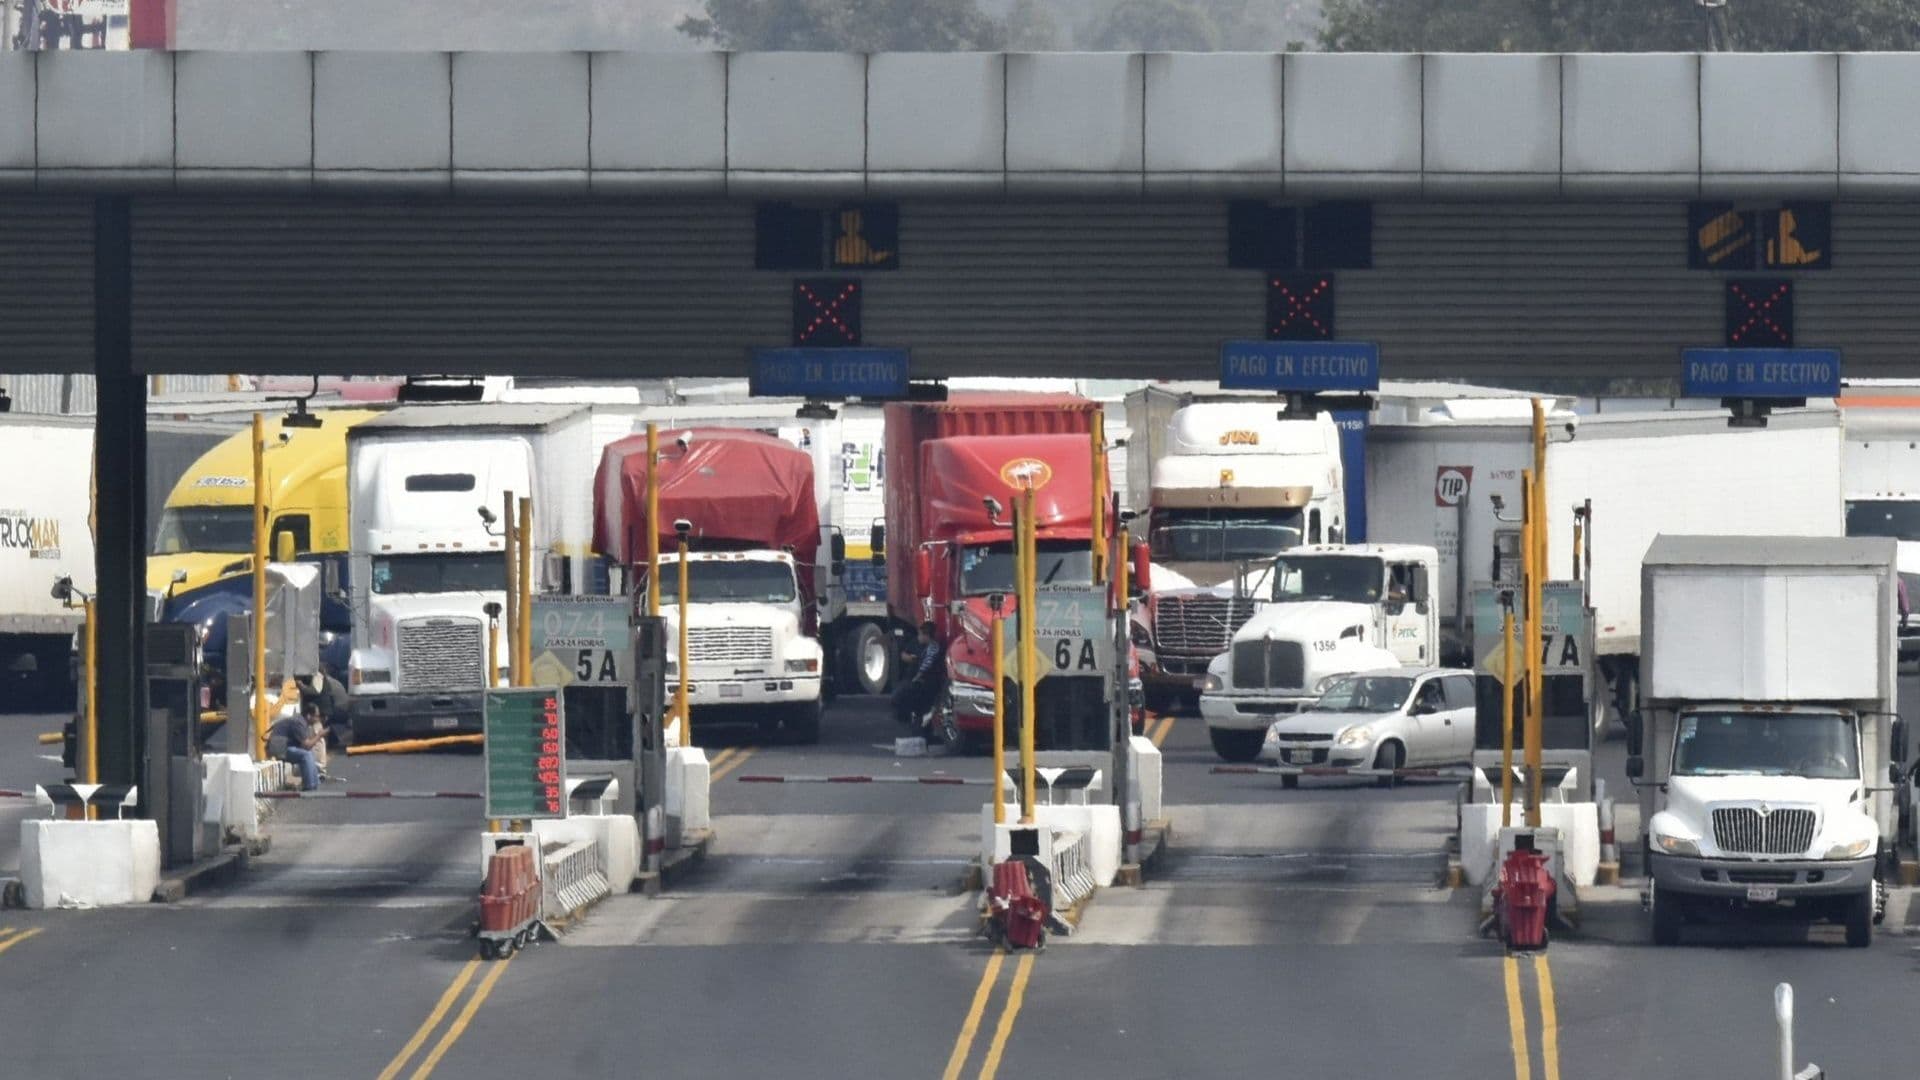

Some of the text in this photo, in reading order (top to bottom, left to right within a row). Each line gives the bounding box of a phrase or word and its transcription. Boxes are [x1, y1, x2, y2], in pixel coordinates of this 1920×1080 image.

[805, 362, 823, 382] EN
[831, 361, 898, 383] EFECTIVO
[1230, 356, 1368, 376] PAGO EN EFECTIVO
[1691, 362, 1830, 382] PAGO EN EFECTIVO
[1442, 478, 1463, 497] TIP
[0, 517, 59, 549] RUCKMAN
[544, 610, 606, 637] 074
[1040, 600, 1081, 628] 74
